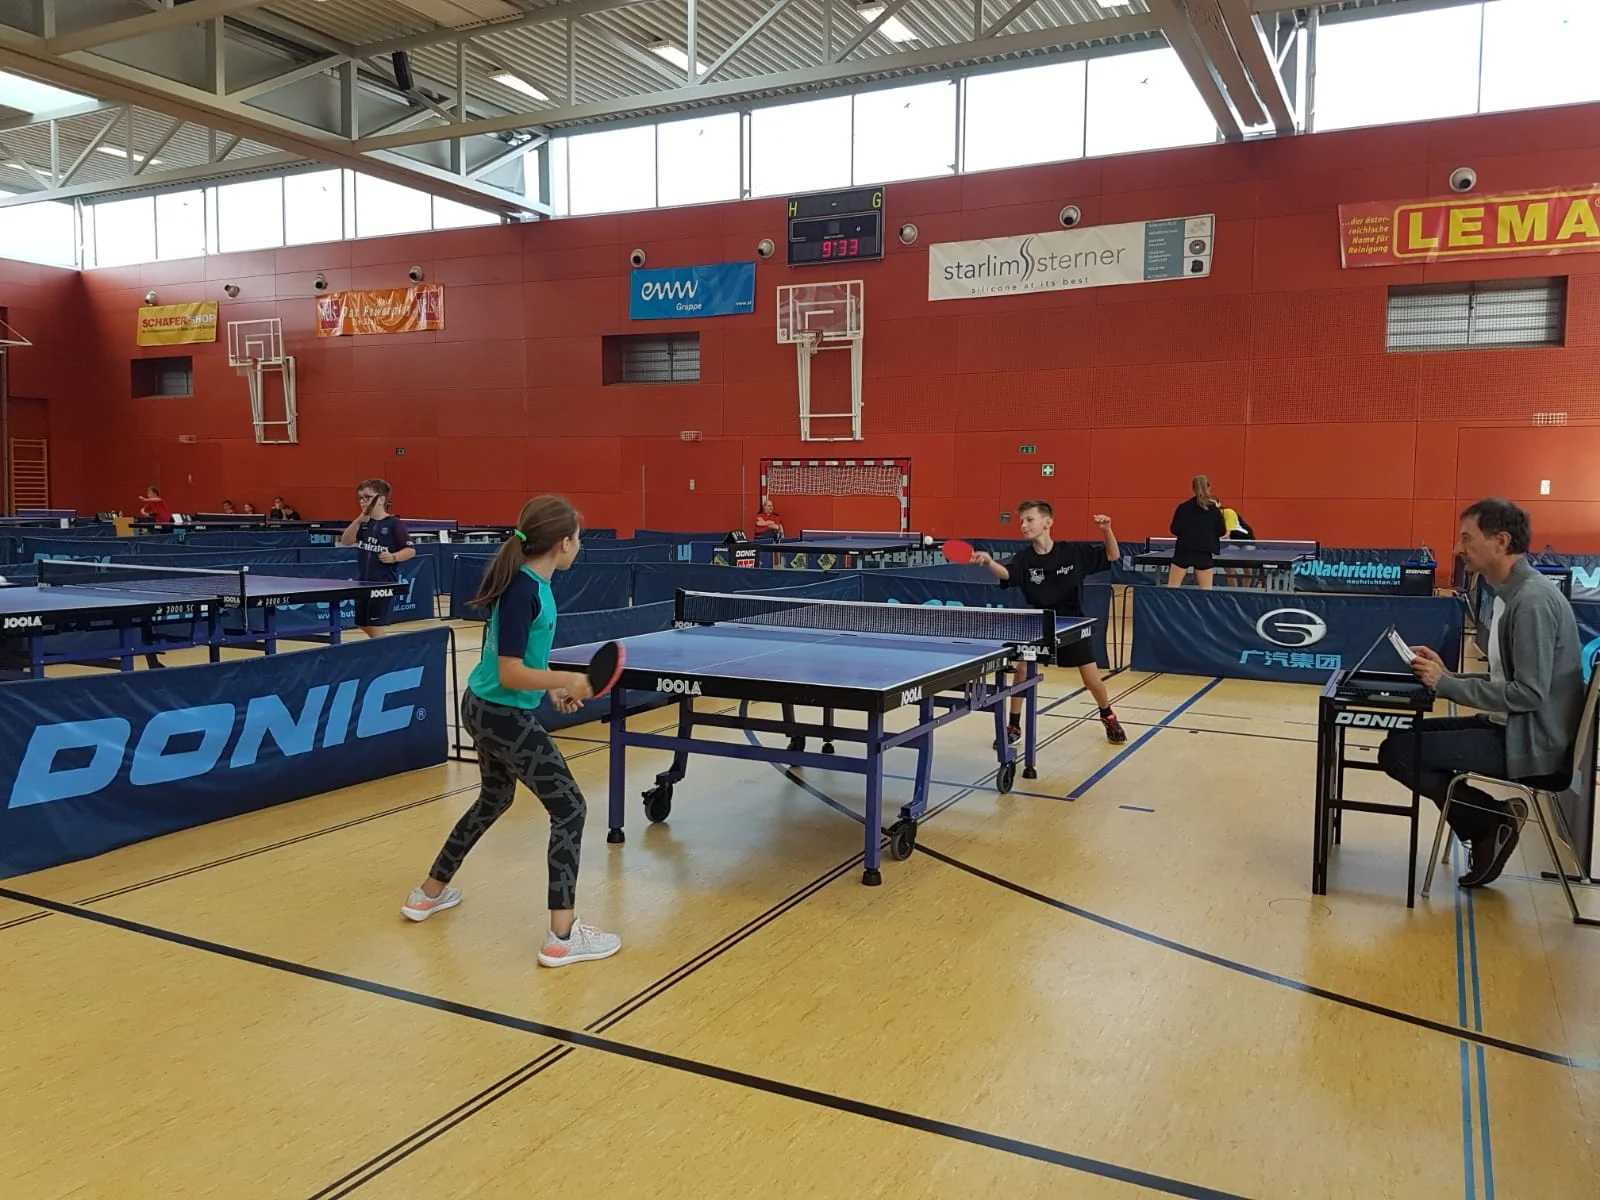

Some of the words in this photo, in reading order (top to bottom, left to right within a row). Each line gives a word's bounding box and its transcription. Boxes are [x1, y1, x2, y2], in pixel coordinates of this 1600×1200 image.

[788, 201, 798, 217] H
[872, 192, 882, 208] G
[1408, 199, 1600, 250] LEMA
[1352, 236, 1375, 245] Name
[1348, 245, 1389, 255] Reinigung
[943, 254, 1020, 281] starlim
[1037, 247, 1126, 272] sterner
[971, 284, 1017, 294] silicone
[1024, 281, 1034, 290] at
[1040, 279, 1056, 288] its
[1062, 276, 1090, 286] best
[676, 302, 702, 312] Gruppe
[370, 588, 393, 598] JOOLA
[3, 615, 42, 629] JOOLA
[1239, 650, 1342, 670] 广汽集团
[656, 677, 702, 696] JOOLA
[900, 685, 923, 706] JOOLA
[1334, 712, 1414, 730] DONIC
[8, 665, 425, 809] DONIC
